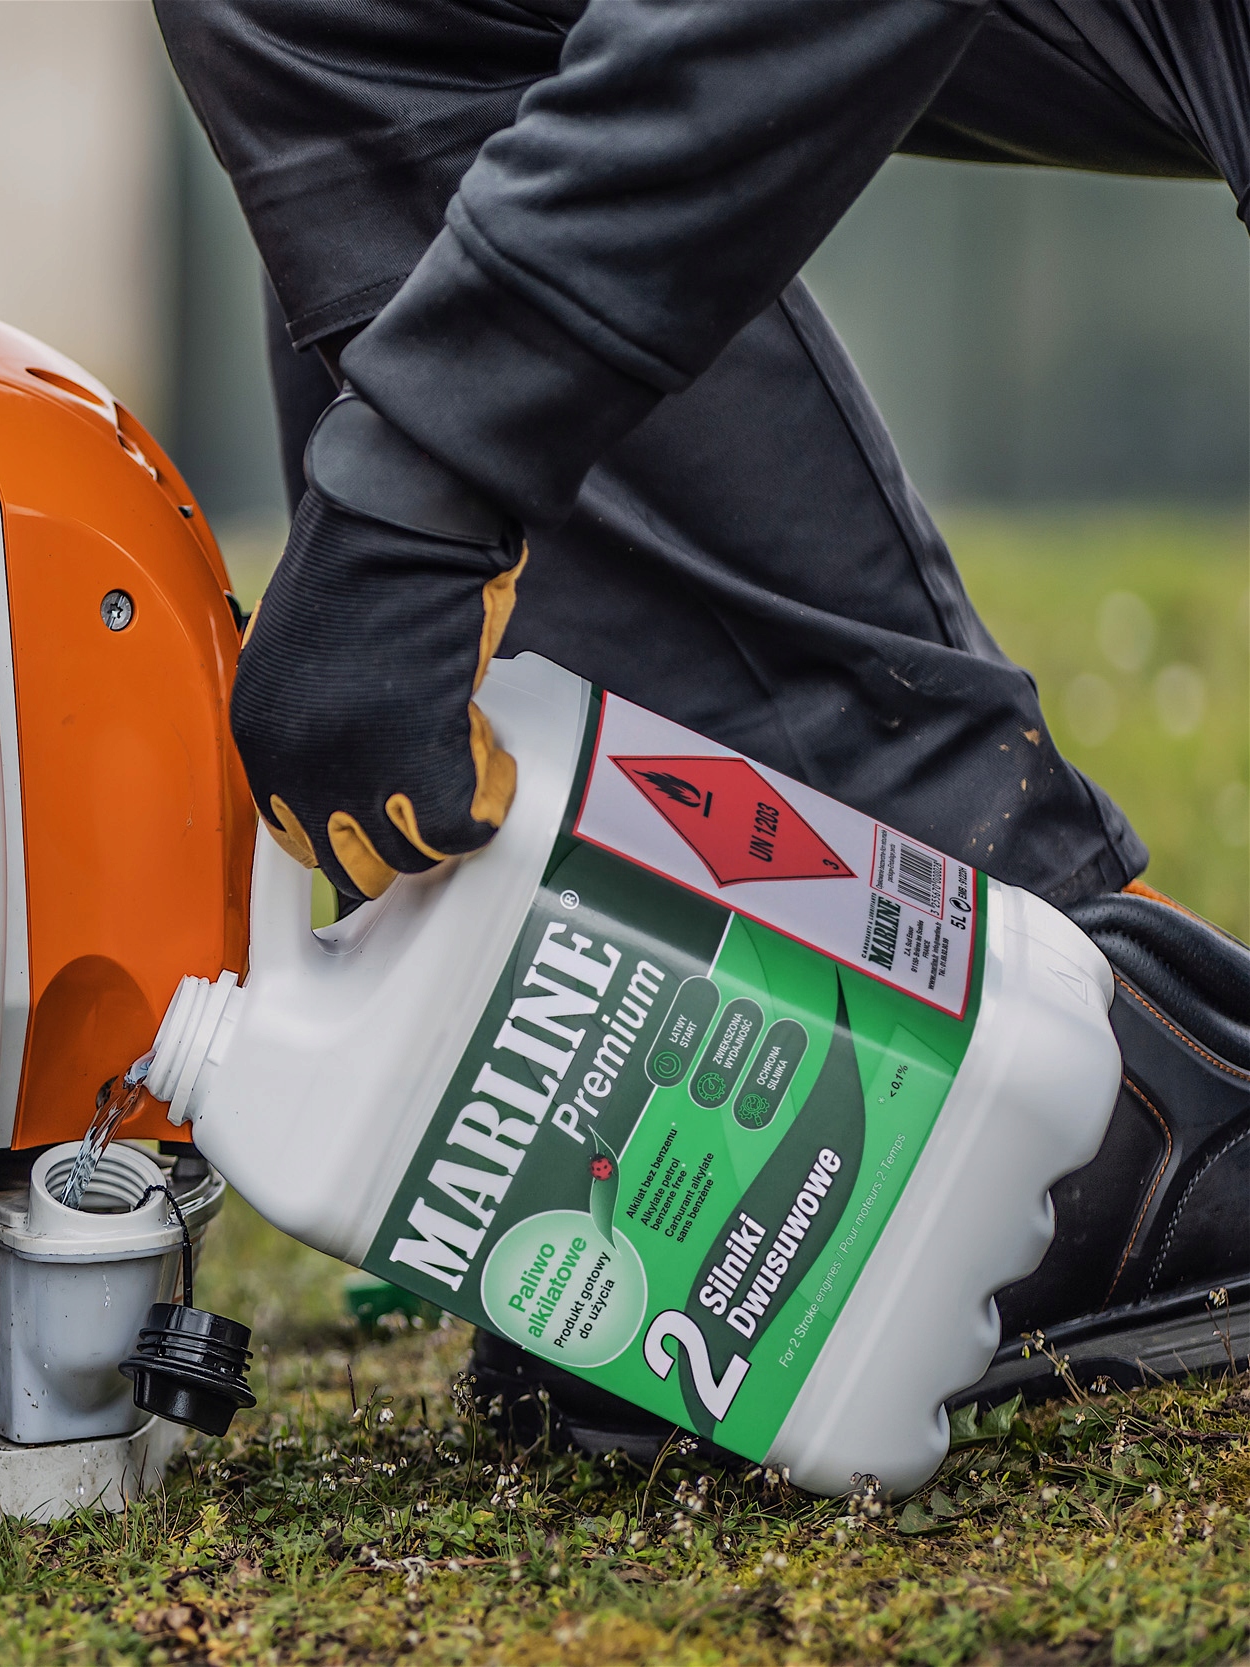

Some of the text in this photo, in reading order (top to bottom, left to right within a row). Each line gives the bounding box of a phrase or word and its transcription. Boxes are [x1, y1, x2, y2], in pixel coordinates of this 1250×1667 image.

[749, 802, 779, 862] UN 1203
[822, 859, 839, 870] 3
[868, 896, 901, 971] MARLINE
[951, 915, 967, 930] 5L
[923, 940, 931, 959] FRANCE
[669, 1014, 688, 1043] ŁATWY
[679, 1020, 697, 1048] START
[712, 1012, 743, 1065] ZWIĘKSZONA
[723, 1019, 753, 1069] WYDAJNOŚĆ
[551, 959, 666, 1145] Premium
[756, 1045, 782, 1086] OCHRONA
[767, 1059, 788, 1091] SILNIKA
[389, 921, 622, 1292] MARLINE
[880, 1131, 906, 1170] Temps
[626, 1188, 647, 1219] Alkilat
[641, 1169, 657, 1188] bez
[640, 1157, 681, 1226] Alkylate petrol
[664, 1152, 714, 1237] Carburant alkylate
[876, 1169, 887, 1181] 2
[650, 1191, 677, 1231] benzene
[855, 1180, 882, 1223] moteurs
[676, 1221, 693, 1243] sans
[725, 1147, 842, 1339] Dwusuwowe
[839, 1227, 859, 1253] Pour
[508, 1243, 555, 1313] Paliwo
[699, 1211, 767, 1316] Silniki
[815, 1261, 842, 1303] engines
[528, 1237, 587, 1338] alkilatowe
[554, 1251, 611, 1348] Produkt gotowy
[579, 1279, 616, 1340] do użycia
[794, 1301, 819, 1337] Stroke
[778, 1350, 795, 1368] For
[789, 1337, 800, 1348] 2
[642, 1308, 752, 1423] 2
